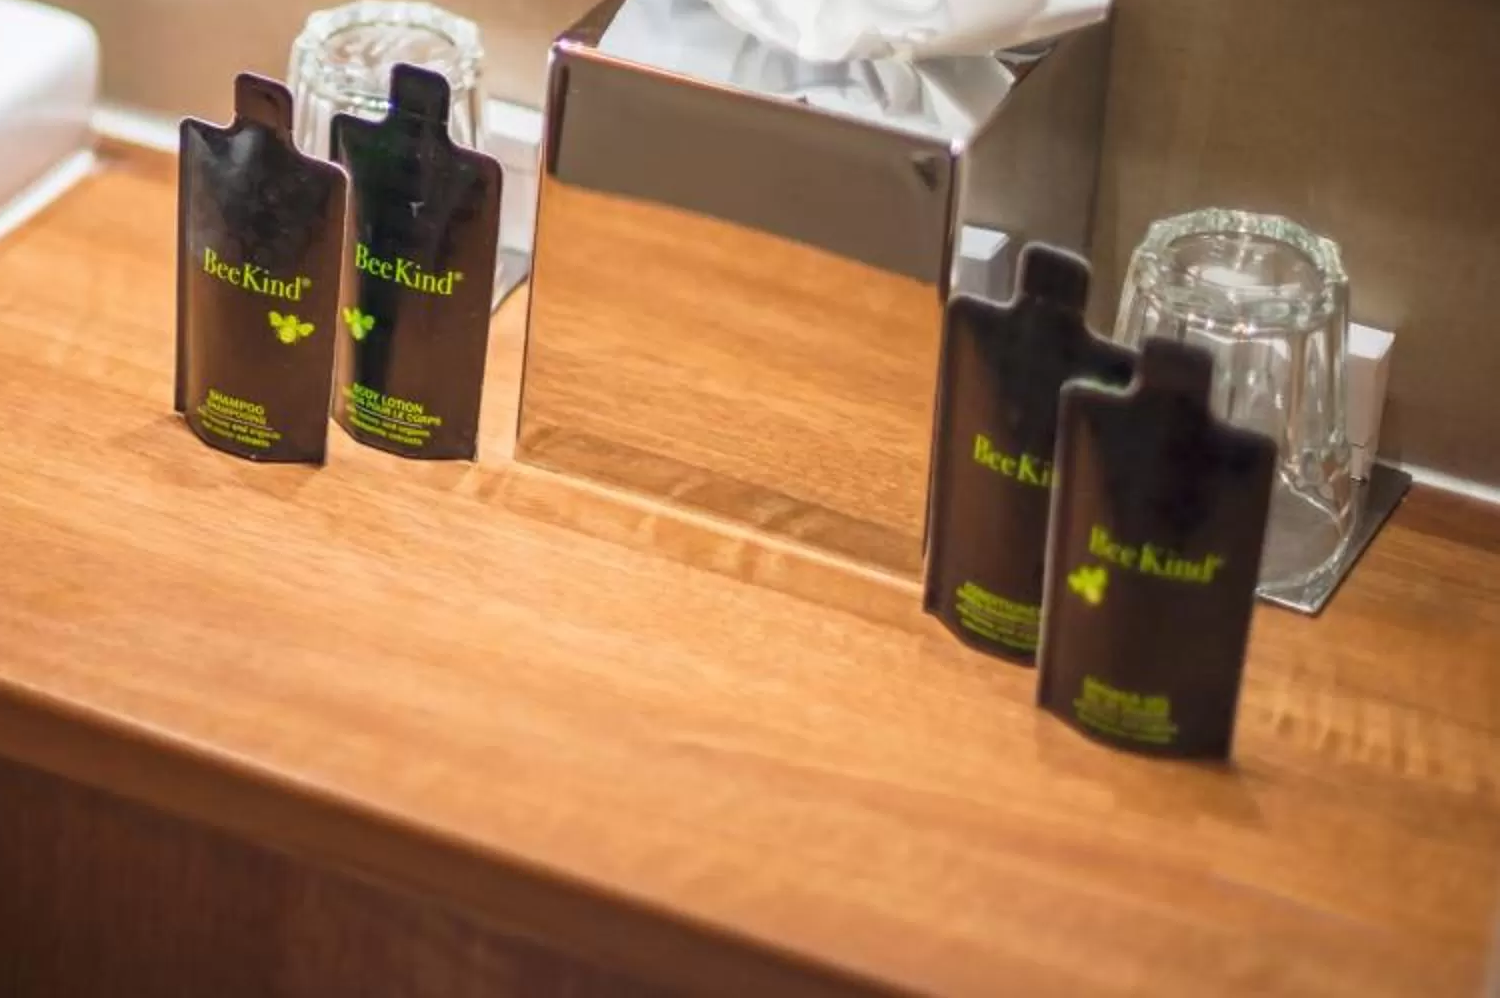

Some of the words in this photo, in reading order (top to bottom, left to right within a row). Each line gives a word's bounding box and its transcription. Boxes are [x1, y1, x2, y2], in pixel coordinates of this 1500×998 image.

[203, 246, 301, 301] BeeKind
[355, 242, 453, 295] BeeKind
[381, 395, 423, 415] LOTION
[1089, 525, 1217, 583] BeeKind
